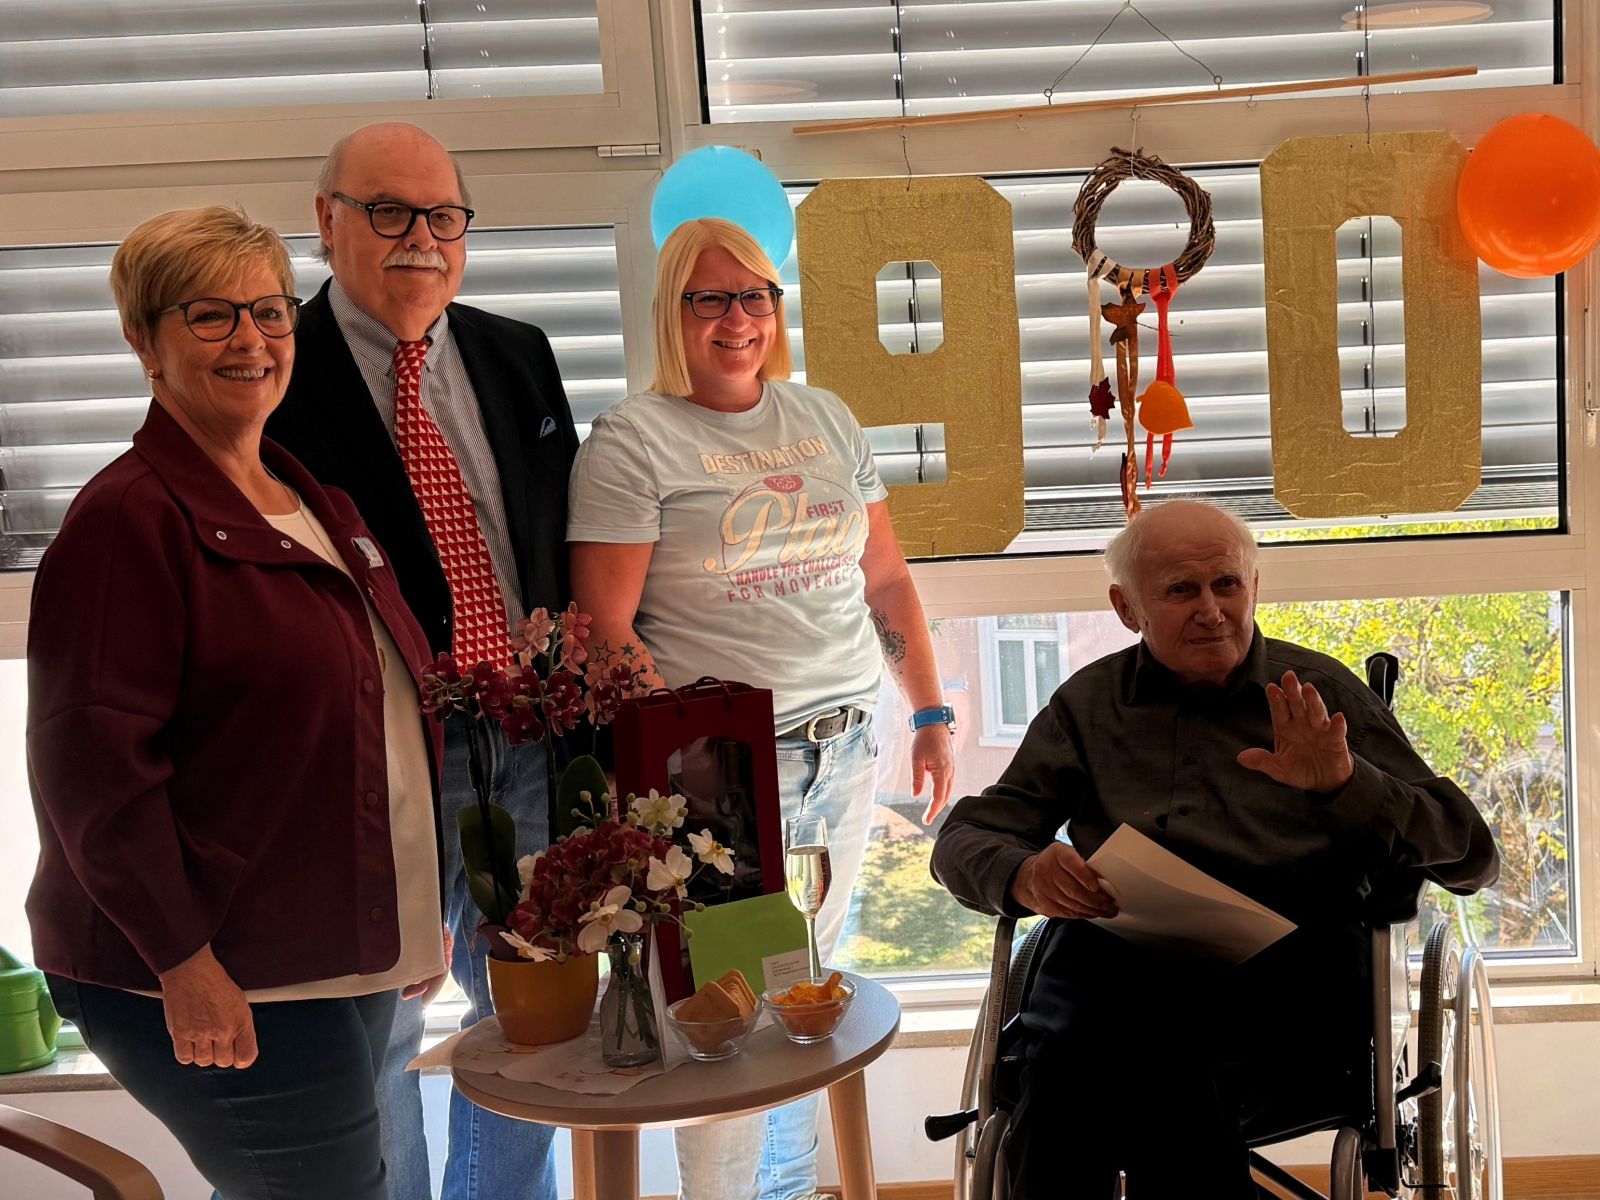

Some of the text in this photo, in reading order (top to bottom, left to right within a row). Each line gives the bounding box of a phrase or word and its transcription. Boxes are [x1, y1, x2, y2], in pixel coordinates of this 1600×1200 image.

[699, 436, 829, 475] DESTINATION
[806, 499, 846, 519] FIRST
[735, 566, 779, 586] HANDLE
[781, 563, 800, 578] THE
[726, 587, 764, 602] FOR
[990, 1004, 1000, 1042] SIEGFRIED
